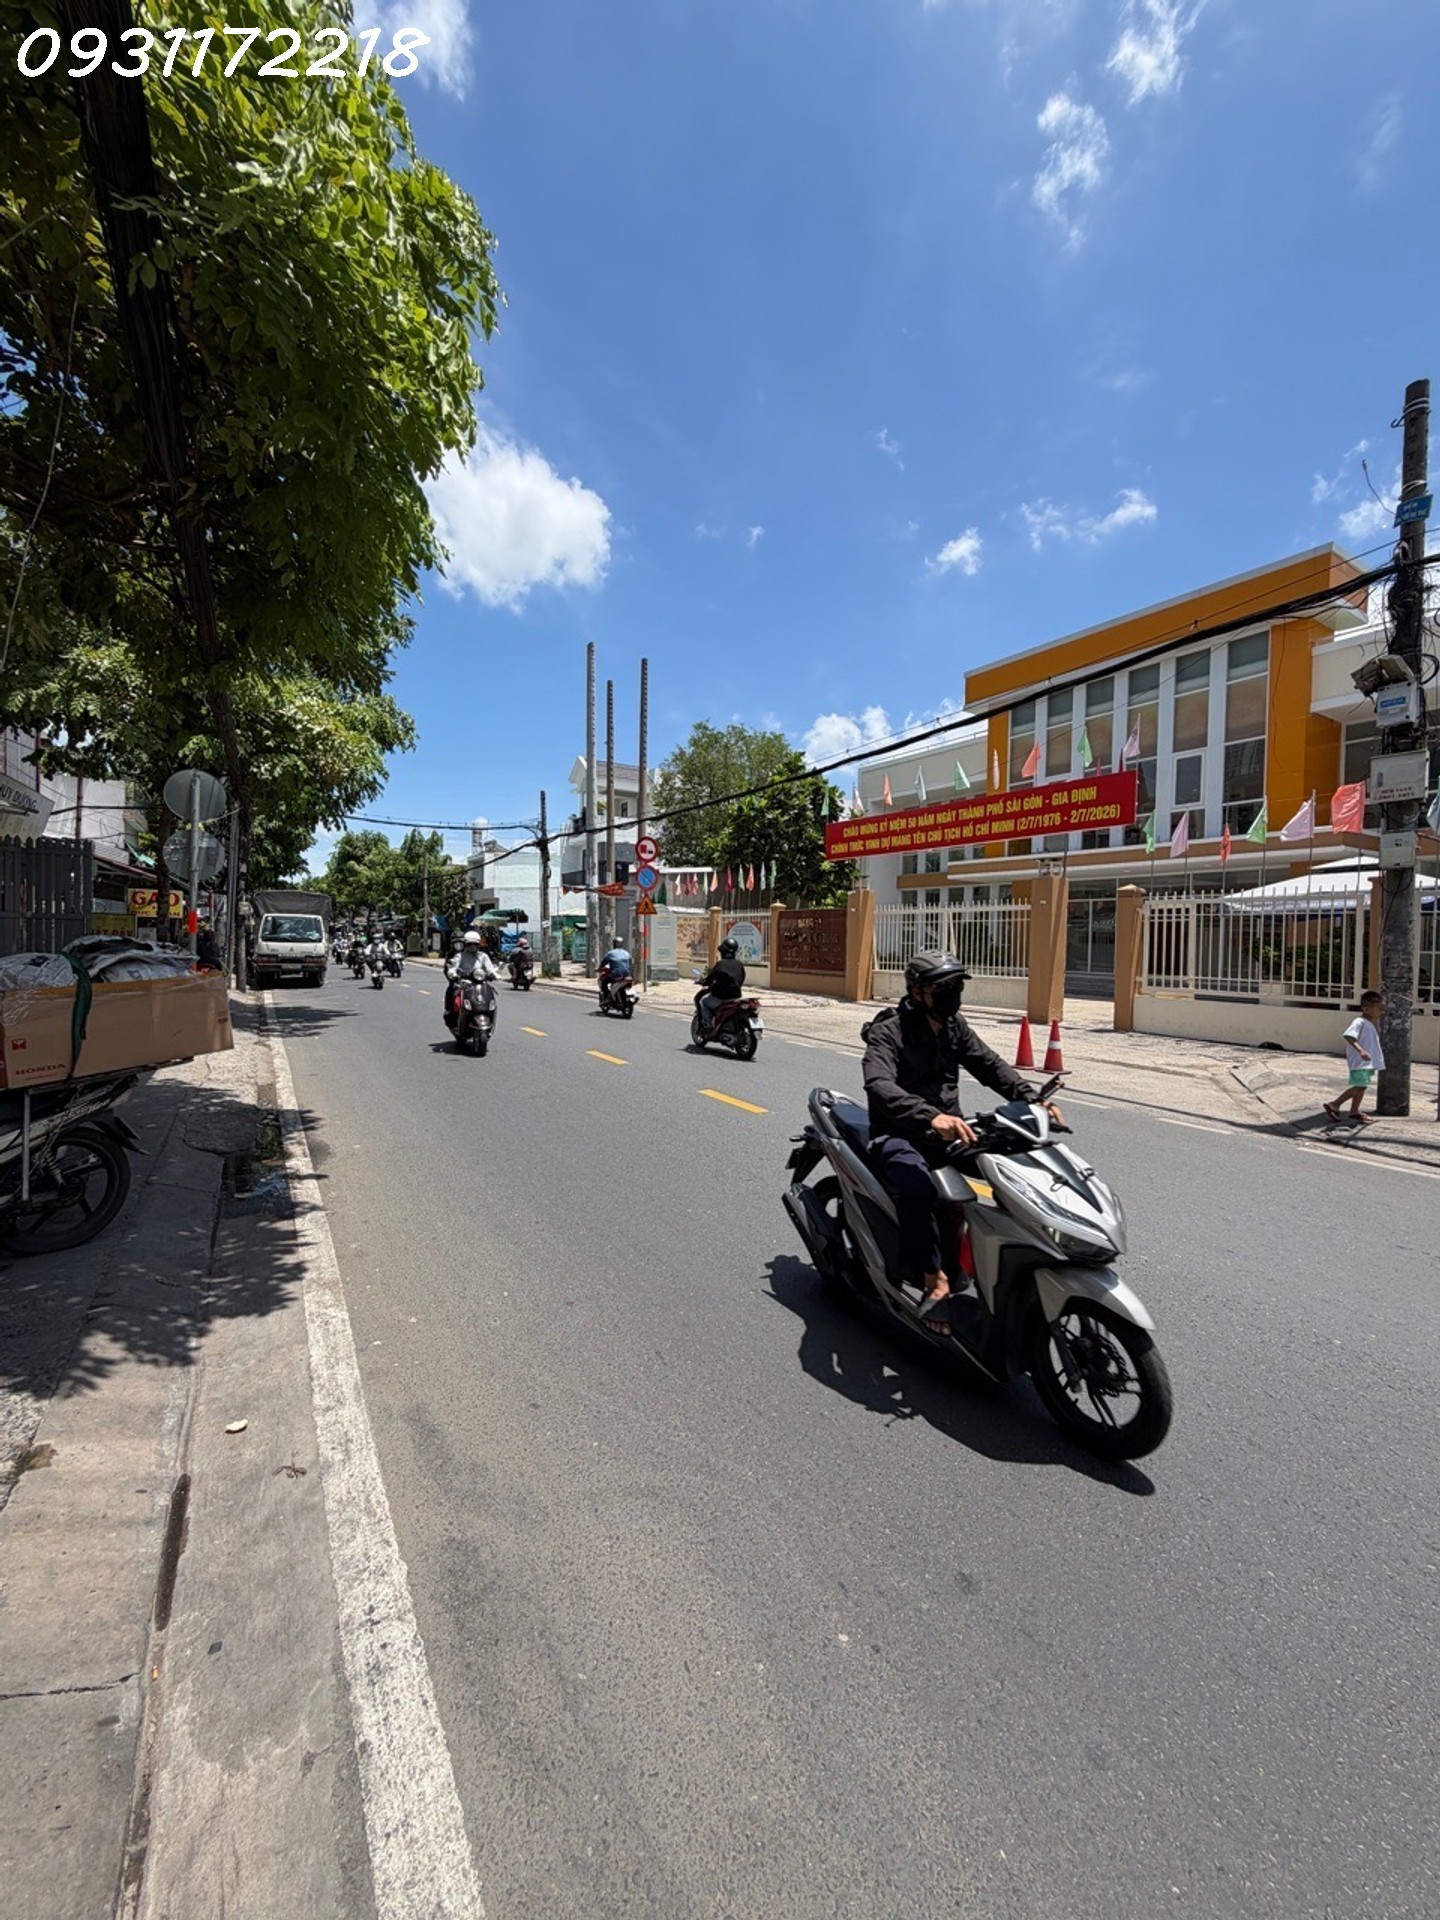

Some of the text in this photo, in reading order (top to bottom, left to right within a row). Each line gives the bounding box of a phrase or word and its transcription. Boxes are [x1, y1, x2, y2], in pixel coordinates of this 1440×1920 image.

[908, 817, 917, 828] 50
[1006, 798, 1021, 813] SÀI
[1023, 794, 1043, 810] GÒN
[1052, 791, 1069, 806] GIA
[1071, 786, 1097, 805] ĐỊNH
[991, 819, 1015, 834] MINH
[1017, 812, 1061, 831] (2/7/1976
[1070, 804, 1120, 823] 2/7/2026)
[15, 1063, 66, 1075] HONDA
